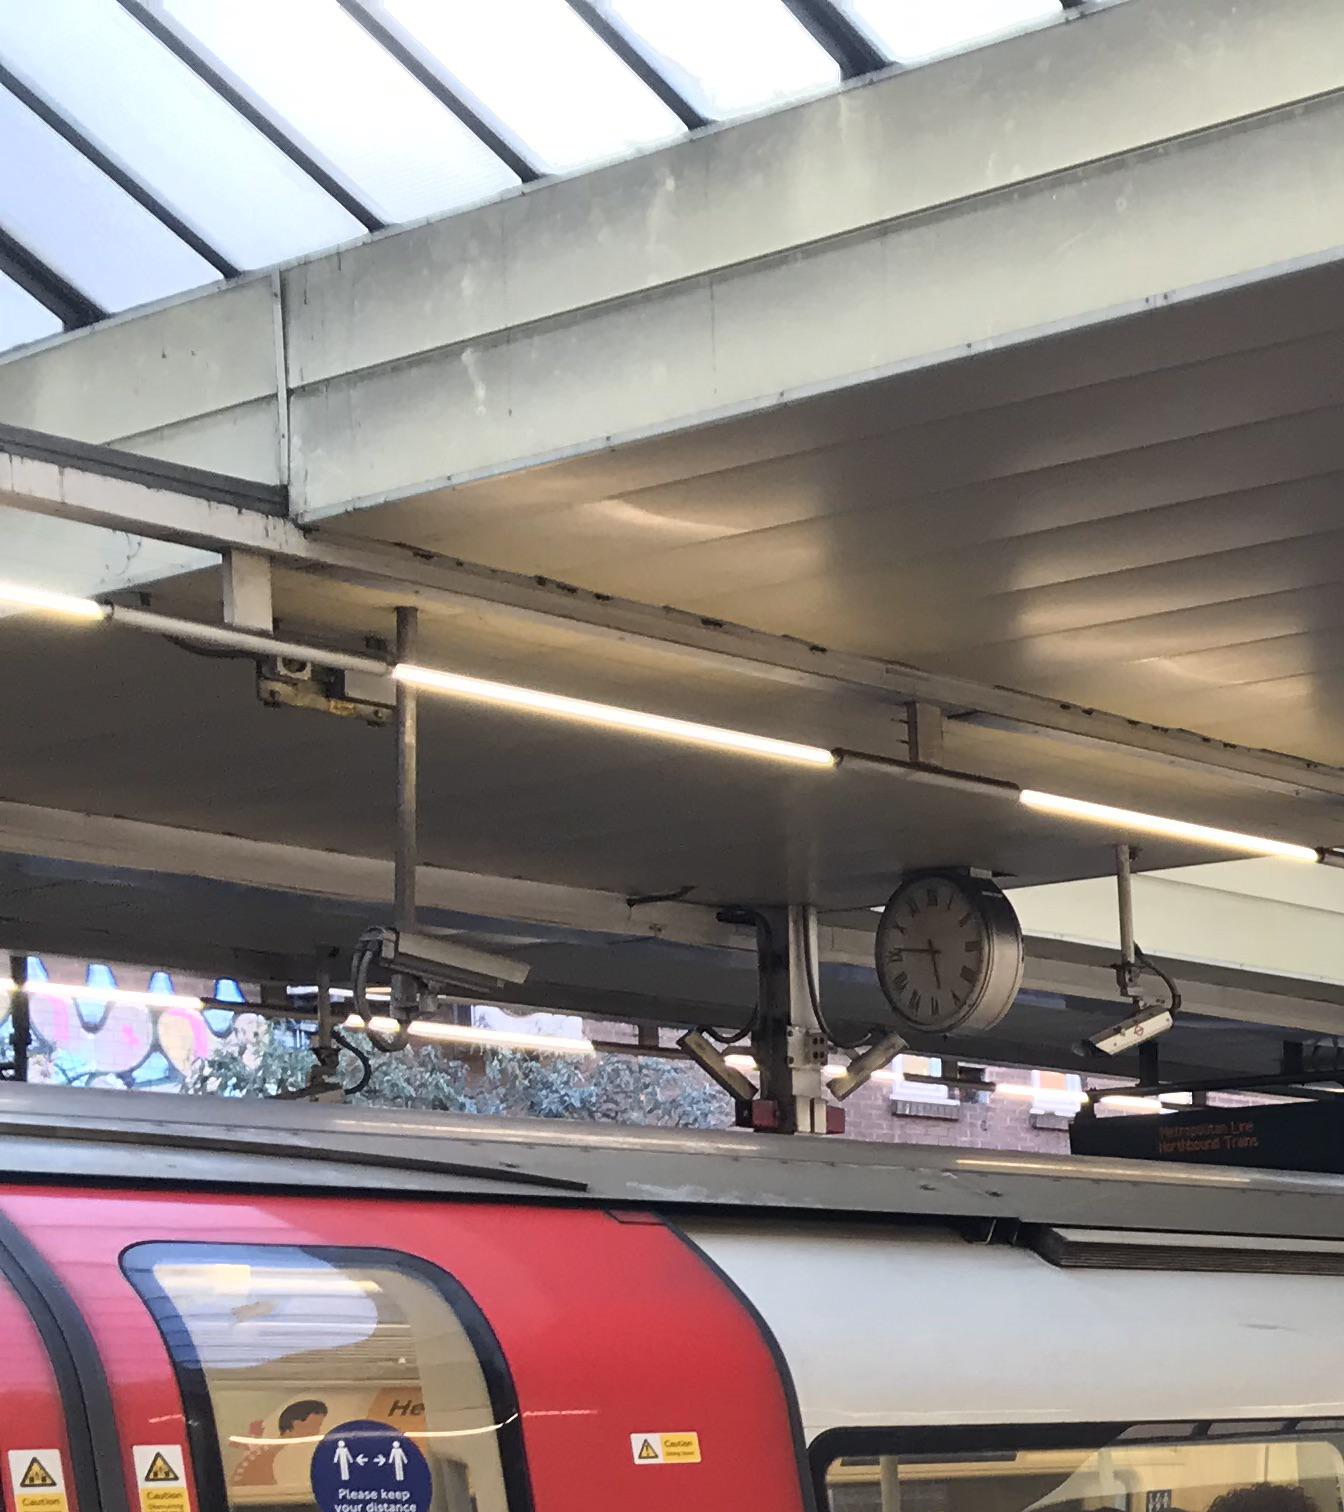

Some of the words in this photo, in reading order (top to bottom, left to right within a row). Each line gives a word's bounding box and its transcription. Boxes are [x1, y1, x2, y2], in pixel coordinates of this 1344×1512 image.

[338, 1488, 378, 1500] Please
[380, 1488, 411, 1501] keep
[366, 1502, 417, 1512] distance
